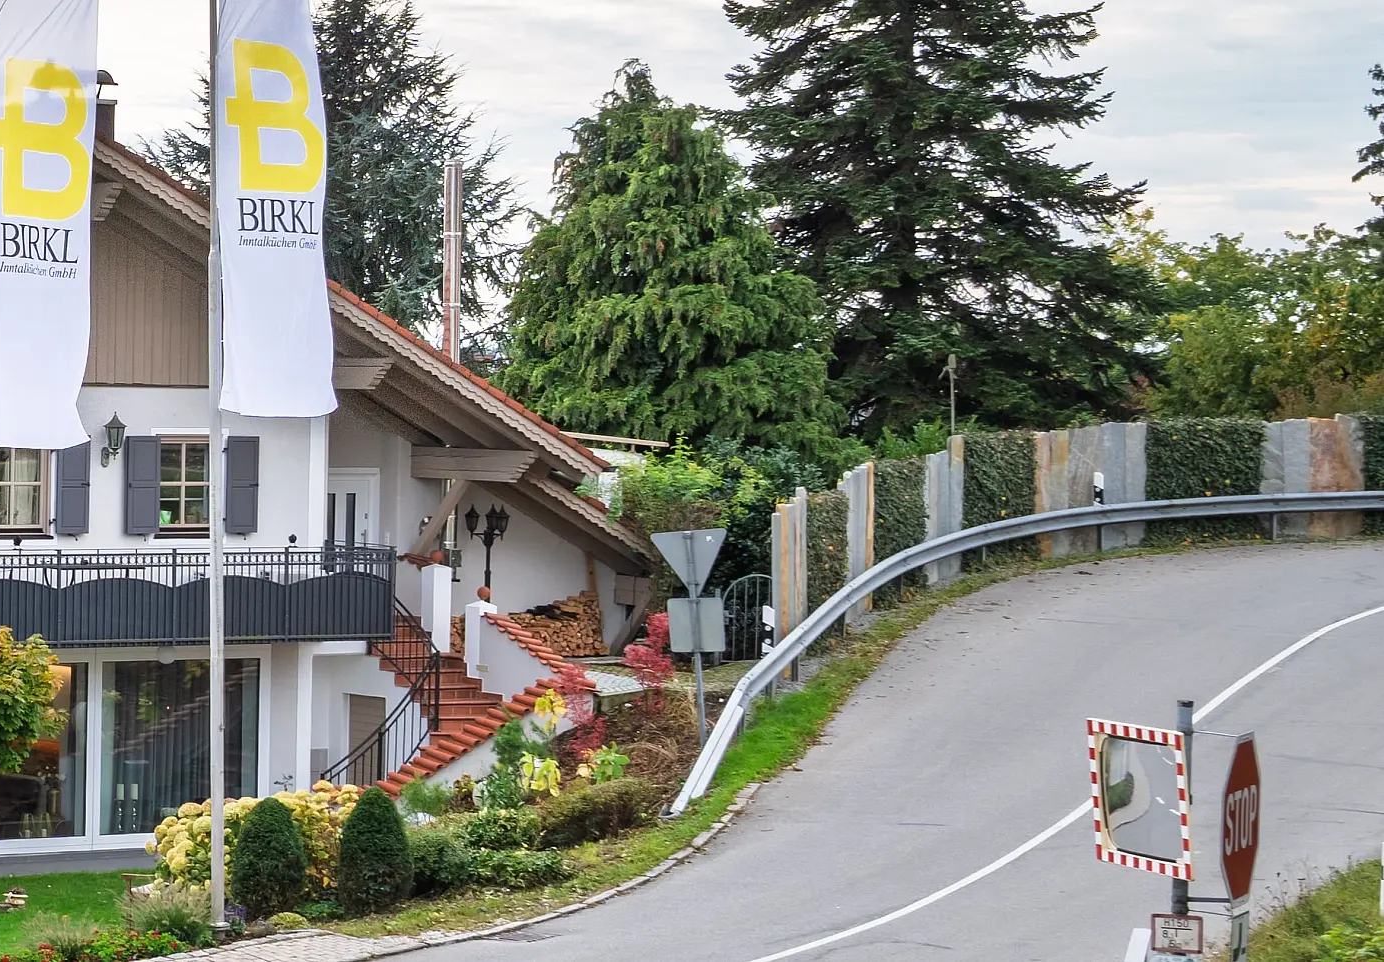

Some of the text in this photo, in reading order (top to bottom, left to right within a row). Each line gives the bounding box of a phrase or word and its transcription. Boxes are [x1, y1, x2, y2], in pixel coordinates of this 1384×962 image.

[225, 38, 324, 193] B
[236, 197, 320, 235] BIRKL
[0, 222, 79, 264] BIRKL
[239, 235, 297, 248] Inntalküchen
[48, 266, 77, 279] GmbH
[1223, 784, 1257, 857] STOP
